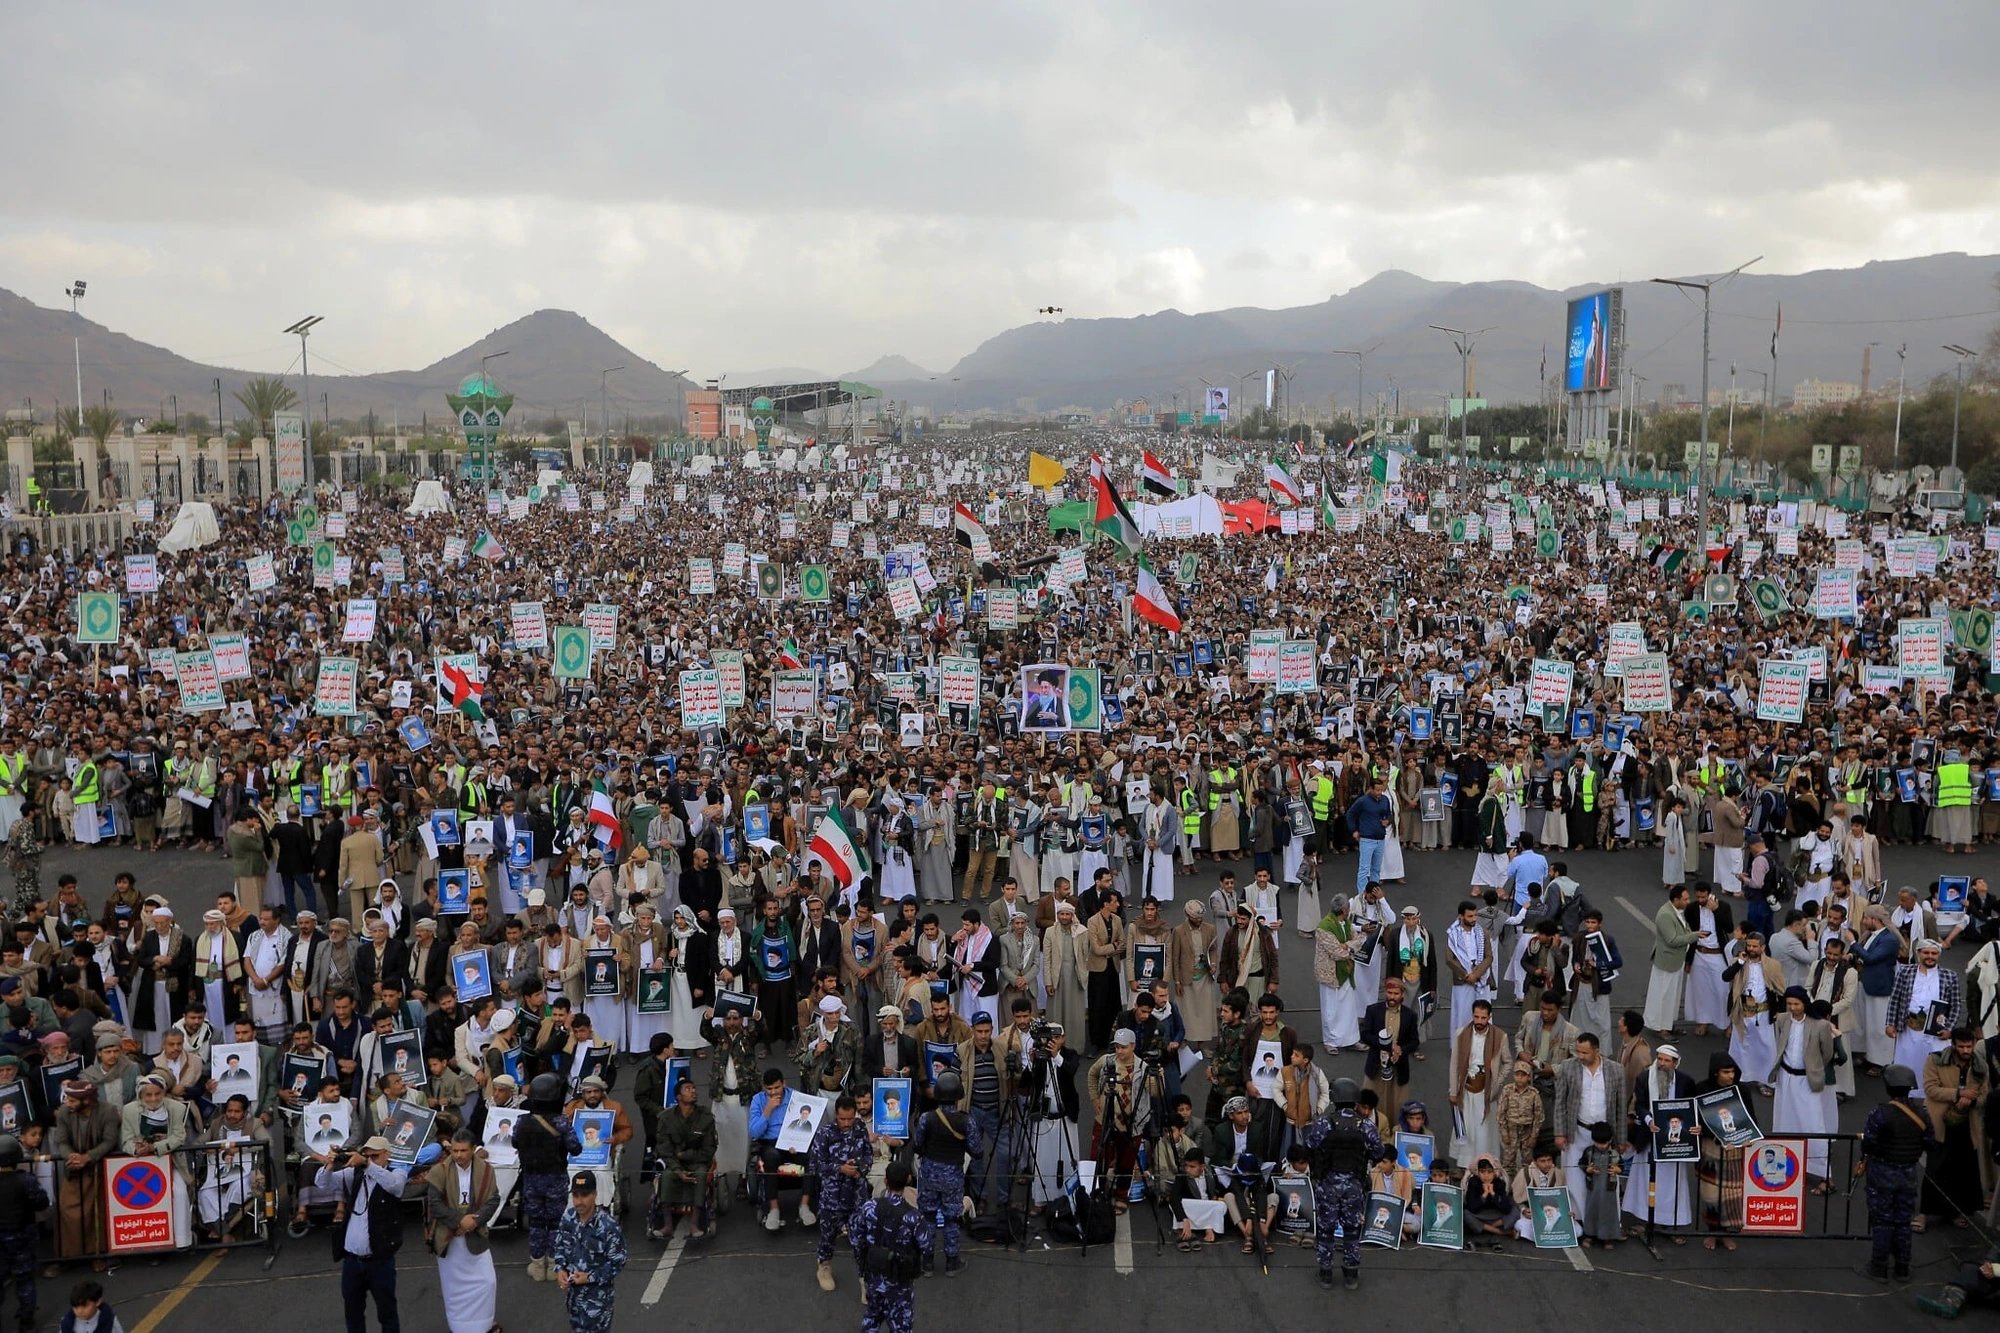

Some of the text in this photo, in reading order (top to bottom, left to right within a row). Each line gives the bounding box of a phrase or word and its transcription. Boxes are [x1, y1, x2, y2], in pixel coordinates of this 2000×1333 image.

[461, 657, 474, 667] الله
[1628, 660, 1652, 672] أكبر
[1536, 663, 1570, 674] الله أكبر
[1768, 666, 1804, 677] الله أكبر
[684, 671, 718, 683] الله أكبر
[1749, 1200, 1796, 1210] ممنوع الوقوف
[1750, 1212, 1794, 1222] أمام الضريح
[116, 1218, 166, 1230] ممنوع الوقوف
[120, 1228, 165, 1241] أمام الضريح
